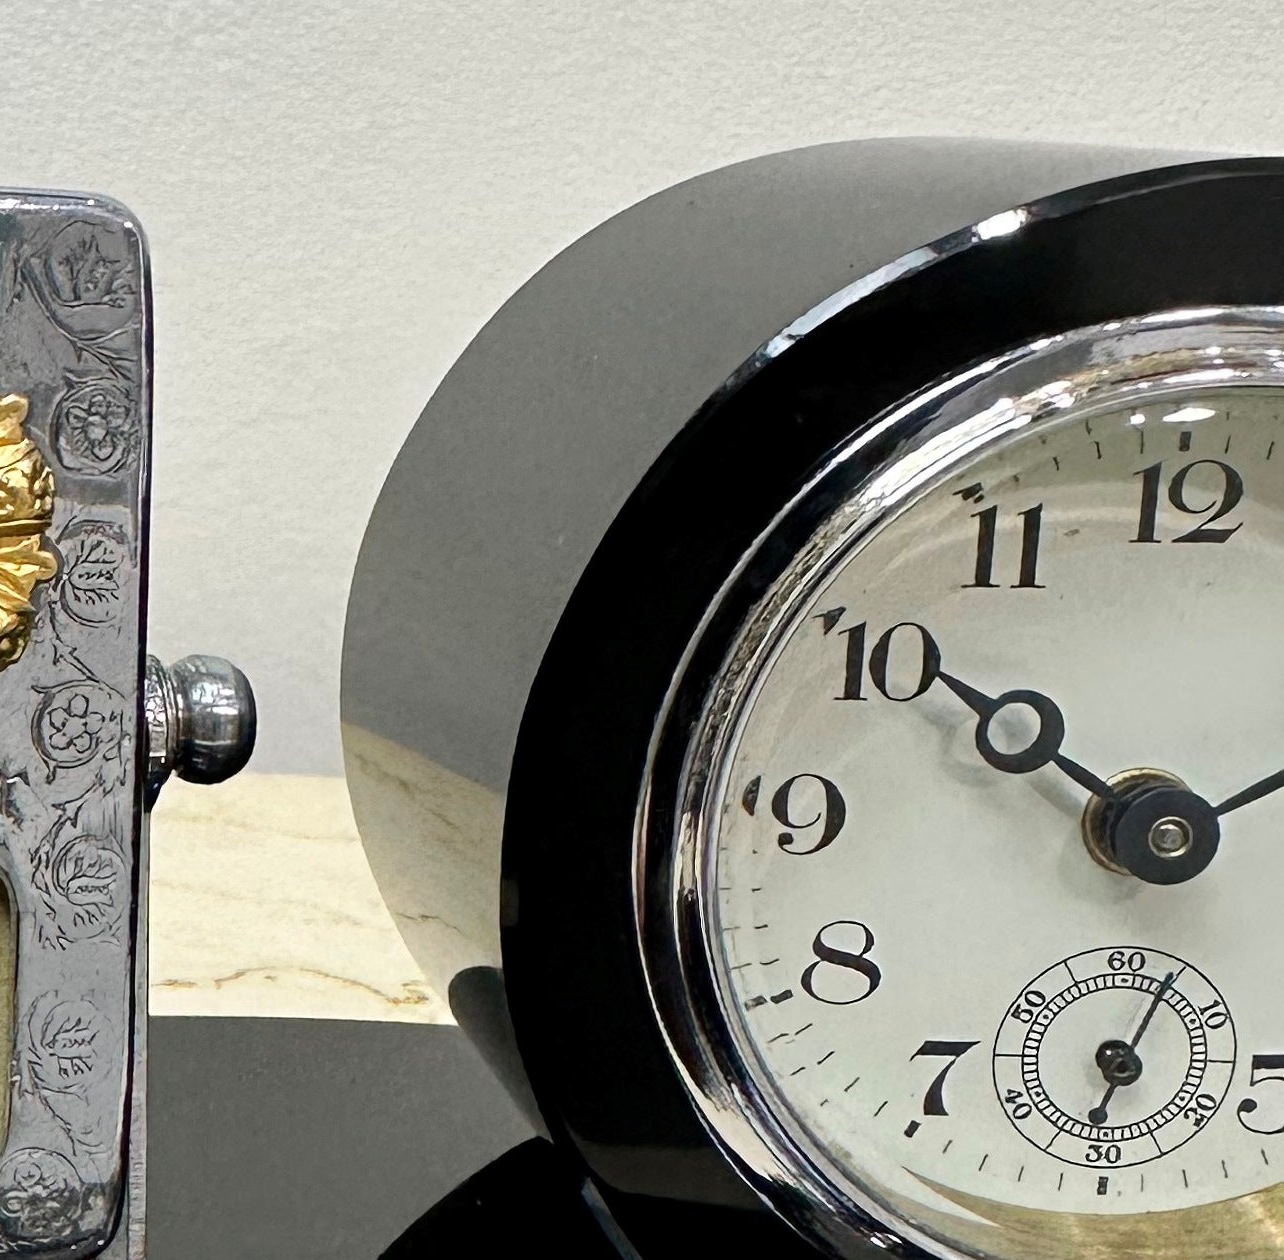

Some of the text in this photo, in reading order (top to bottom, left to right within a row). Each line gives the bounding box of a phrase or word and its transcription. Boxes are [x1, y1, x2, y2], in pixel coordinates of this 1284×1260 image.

[1129, 459, 1244, 543] 12
[961, 503, 1047, 589] 11
[833, 621, 942, 702] 10
[771, 773, 847, 856] 9
[800, 919, 883, 1005] 8
[1107, 951, 1147, 972] 60
[1011, 989, 1047, 1024] 50
[1197, 999, 1229, 1030] 10
[909, 1040, 982, 1116] 7
[1004, 1088, 1033, 1120] 40
[1183, 1093, 1218, 1128] 20
[1084, 1144, 1122, 1164] 30
